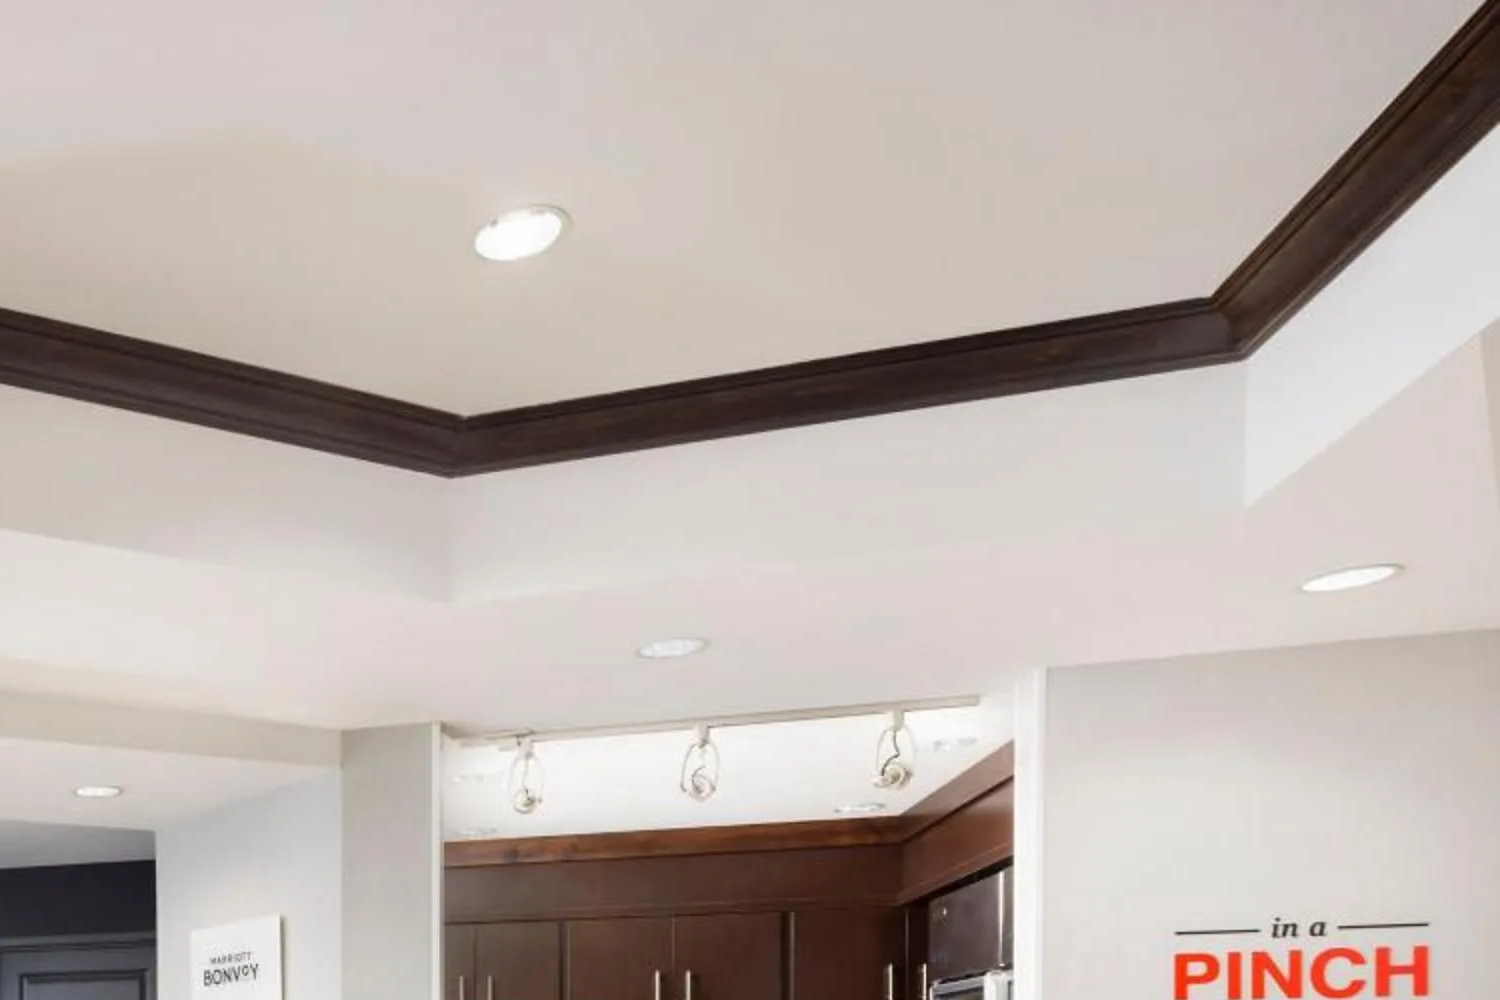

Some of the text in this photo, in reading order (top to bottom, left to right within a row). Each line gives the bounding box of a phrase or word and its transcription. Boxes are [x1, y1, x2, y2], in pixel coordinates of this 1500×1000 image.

[1271, 917, 1327, 938] in a
[203, 963, 259, 987] BONVOY
